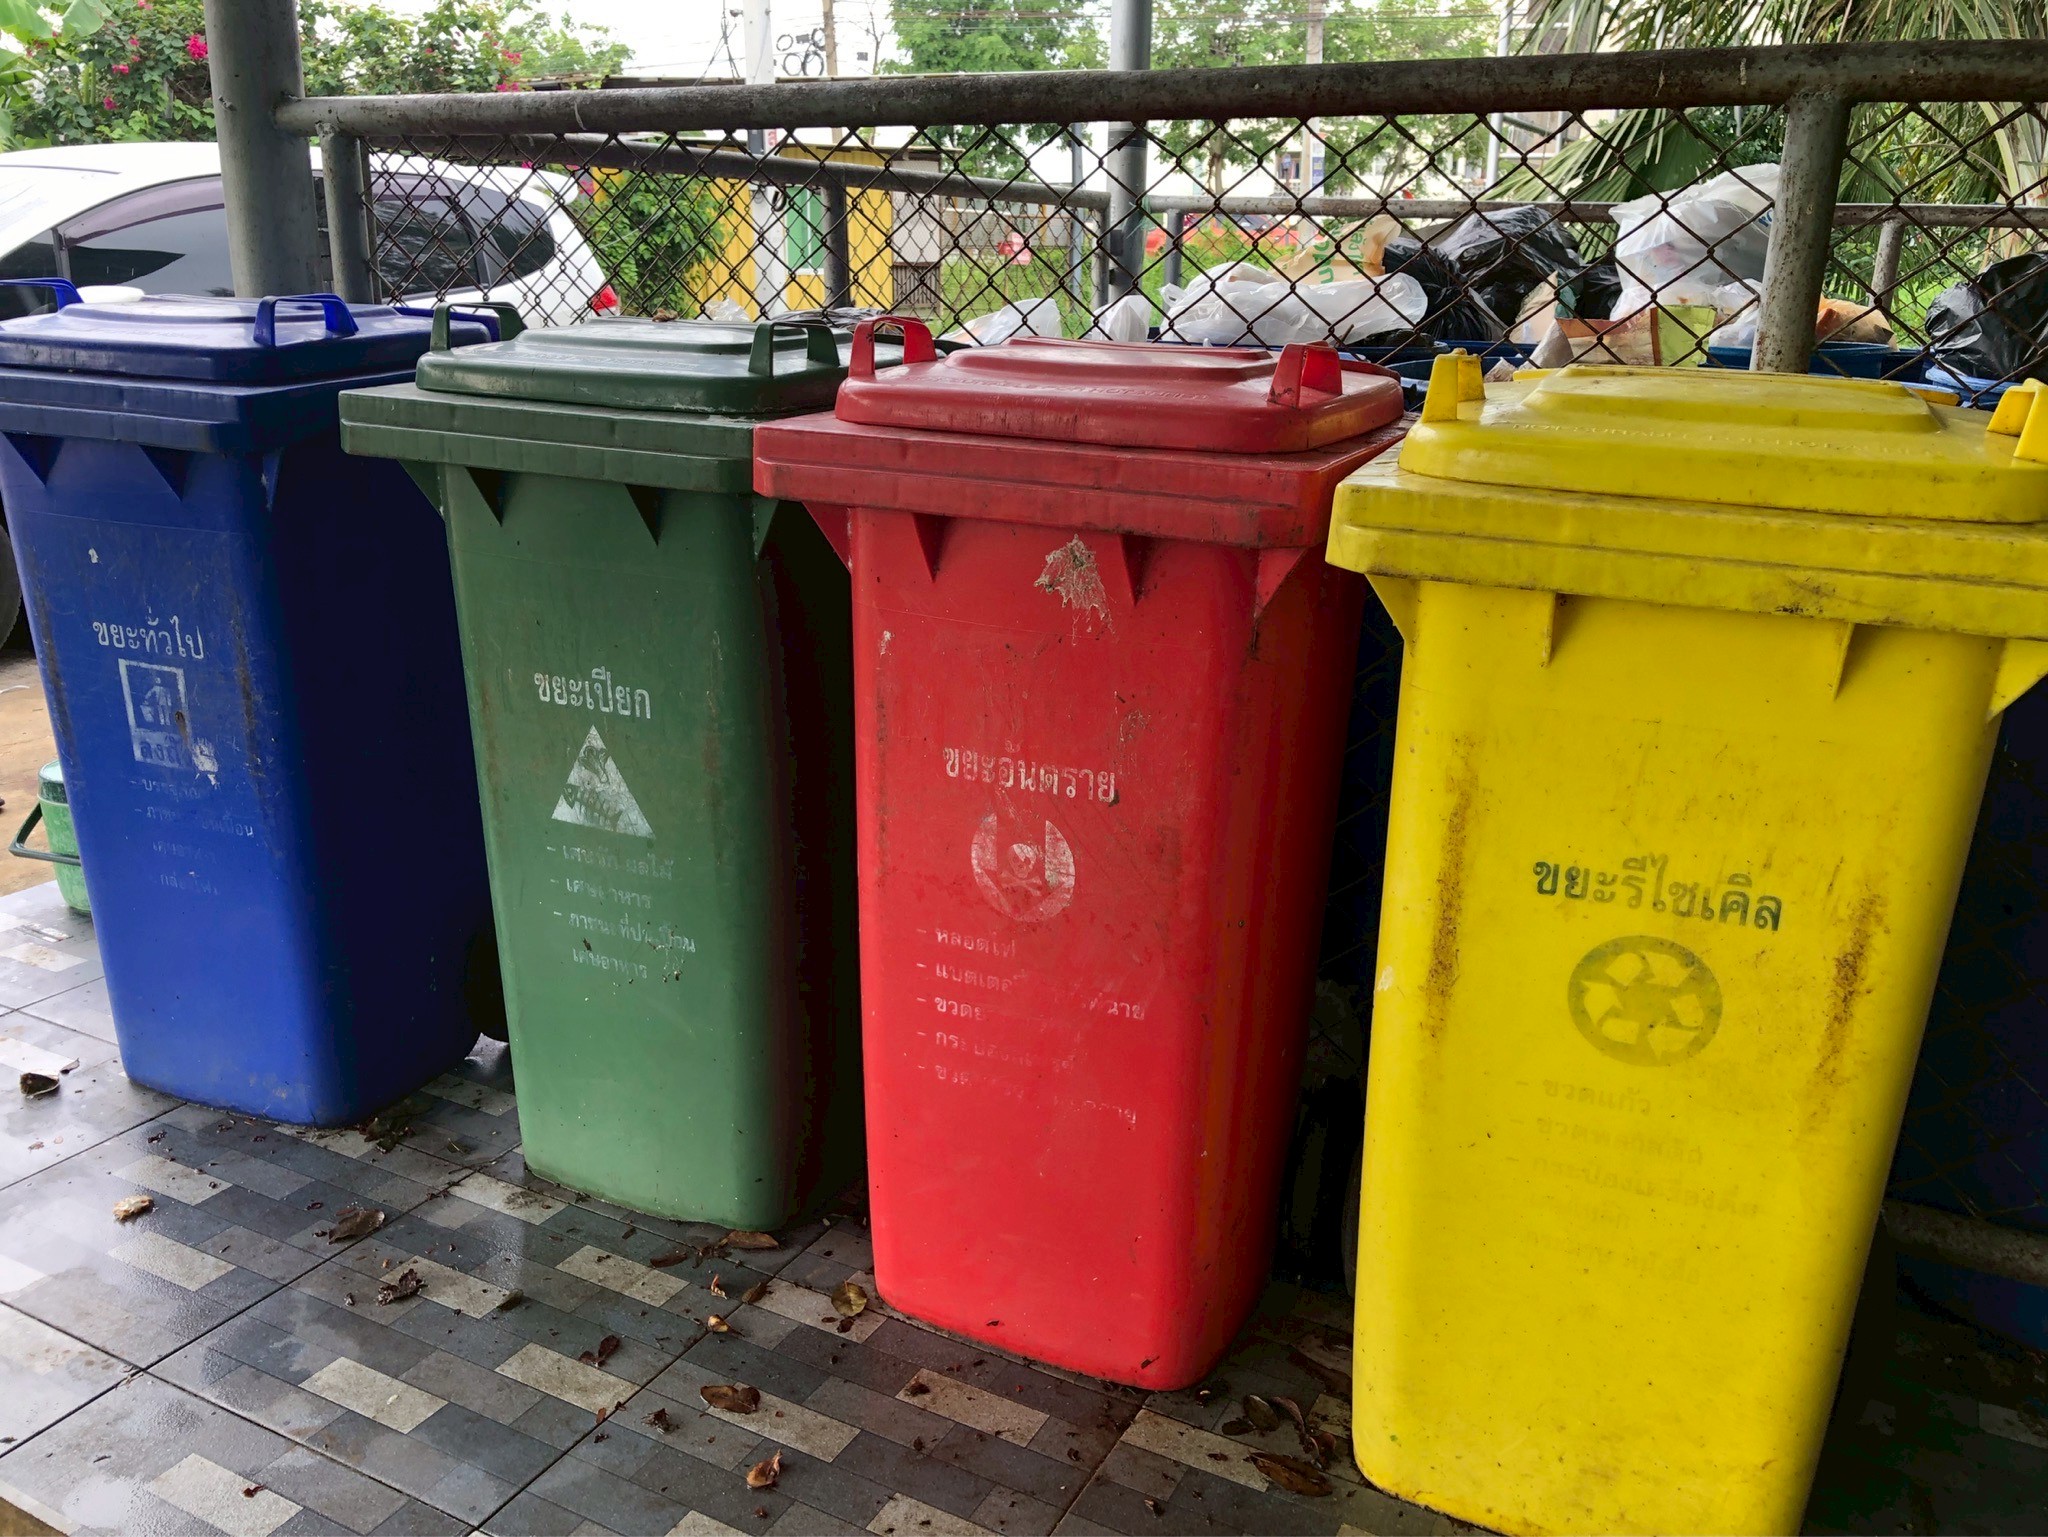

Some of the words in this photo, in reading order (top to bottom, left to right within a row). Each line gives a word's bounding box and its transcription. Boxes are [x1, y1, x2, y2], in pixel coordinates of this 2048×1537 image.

[92, 605, 204, 659] ขยะทั่วไป
[534, 665, 651, 719] ขยะเปียก
[942, 739, 1116, 803] ขยะอันตราย
[1532, 852, 1783, 932] ขยะรีไซเคิล
[1541, 1079, 1651, 1117] ขวดแก้ว
